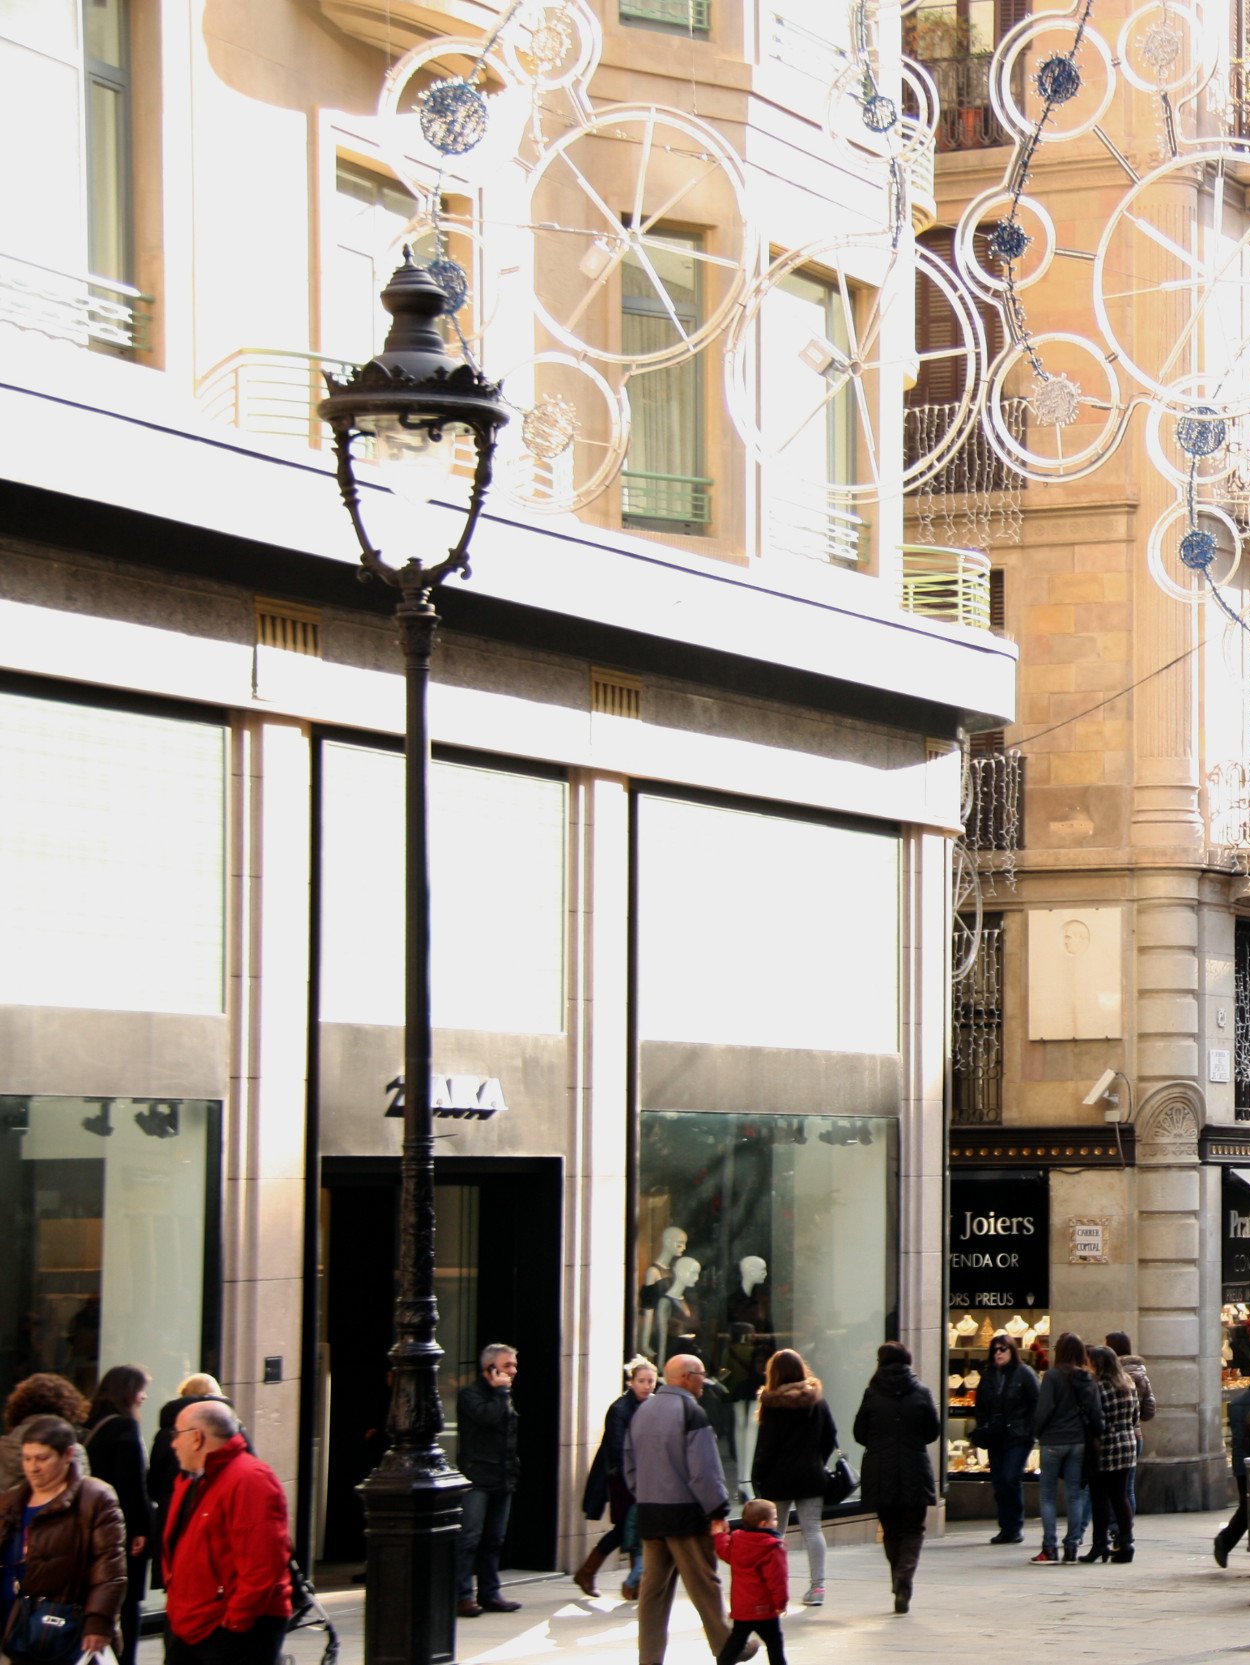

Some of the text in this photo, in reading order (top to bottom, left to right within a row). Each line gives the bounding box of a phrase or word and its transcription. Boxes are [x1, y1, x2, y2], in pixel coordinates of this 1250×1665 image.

[960, 1211, 1034, 1240] Joiers
[1077, 1229, 1100, 1237] CARRER
[1076, 1243, 1100, 1251] COMTAL
[996, 1252, 1019, 1268] OR
[975, 1292, 1014, 1306] PREUS
